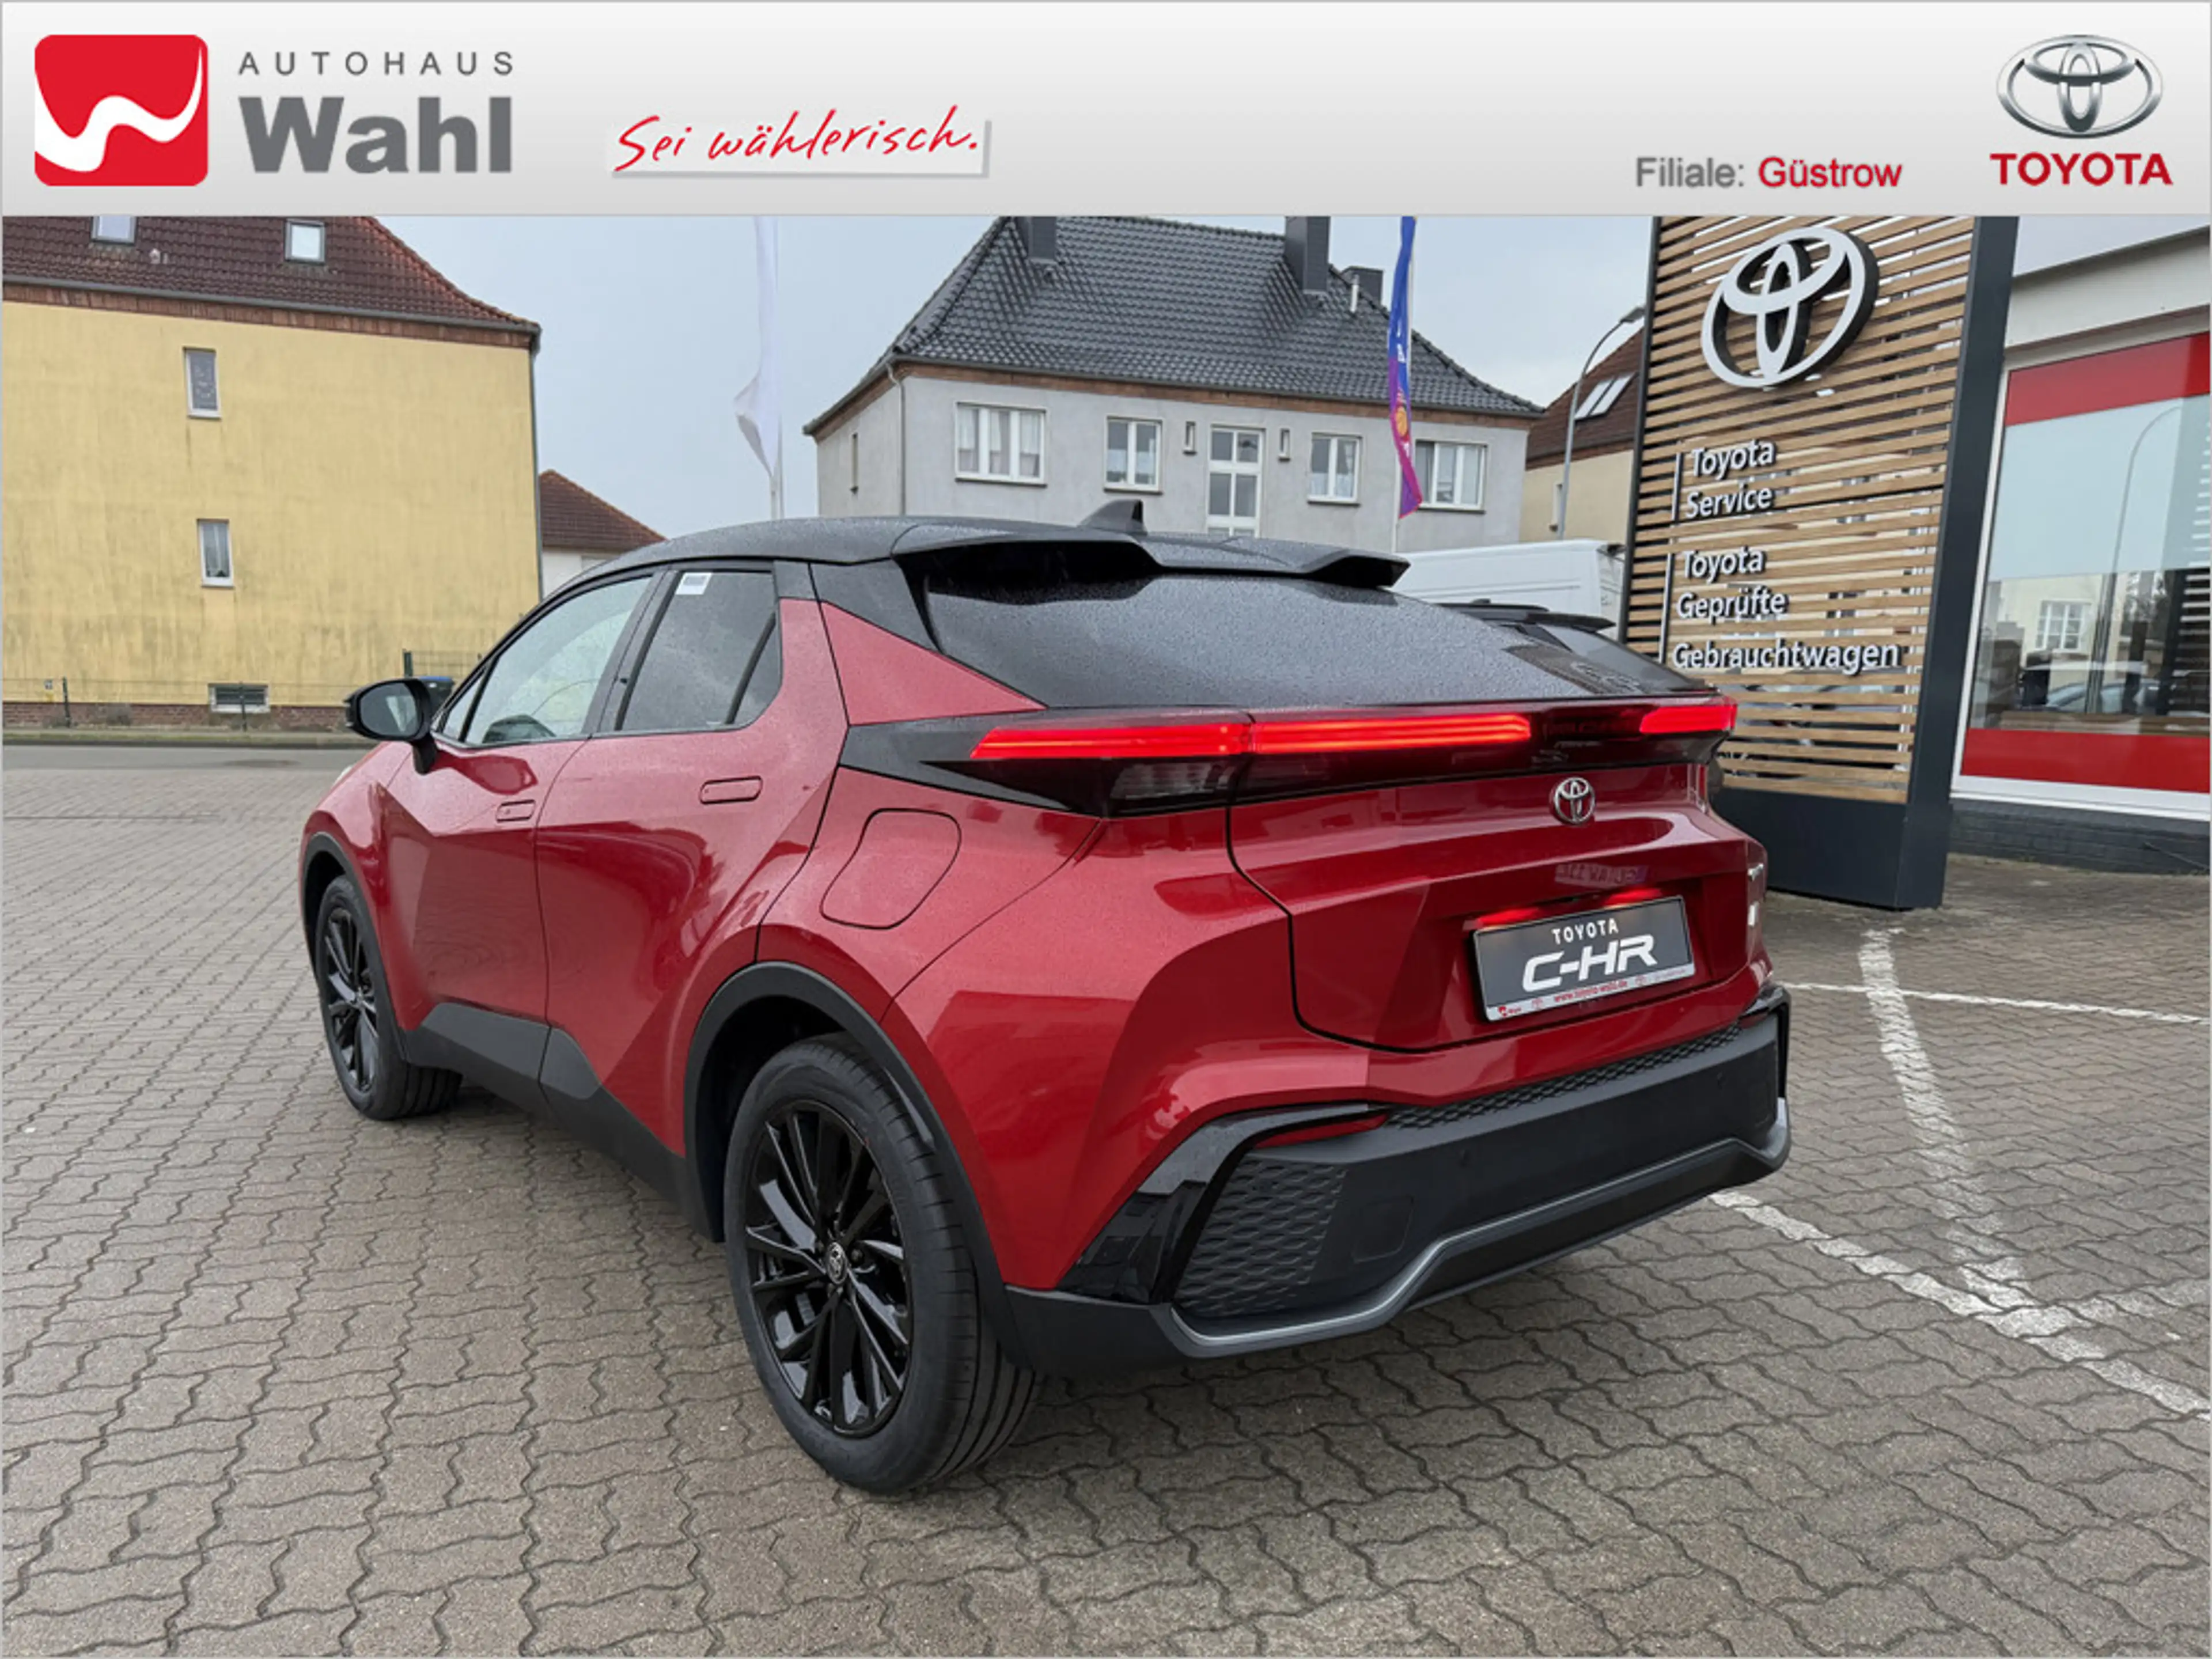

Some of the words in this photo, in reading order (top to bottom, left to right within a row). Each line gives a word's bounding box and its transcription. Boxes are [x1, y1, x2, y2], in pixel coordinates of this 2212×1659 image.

[1691, 440, 1777, 480] Toyota
[1685, 483, 1773, 518] Service
[1681, 547, 1766, 584] Toyota
[1676, 586, 1789, 625] Geprüfte
[1673, 639, 1901, 676] Gebrauchtwagen
[1551, 918, 1619, 945] TOYOTA
[1522, 933, 1658, 993] C-HR
